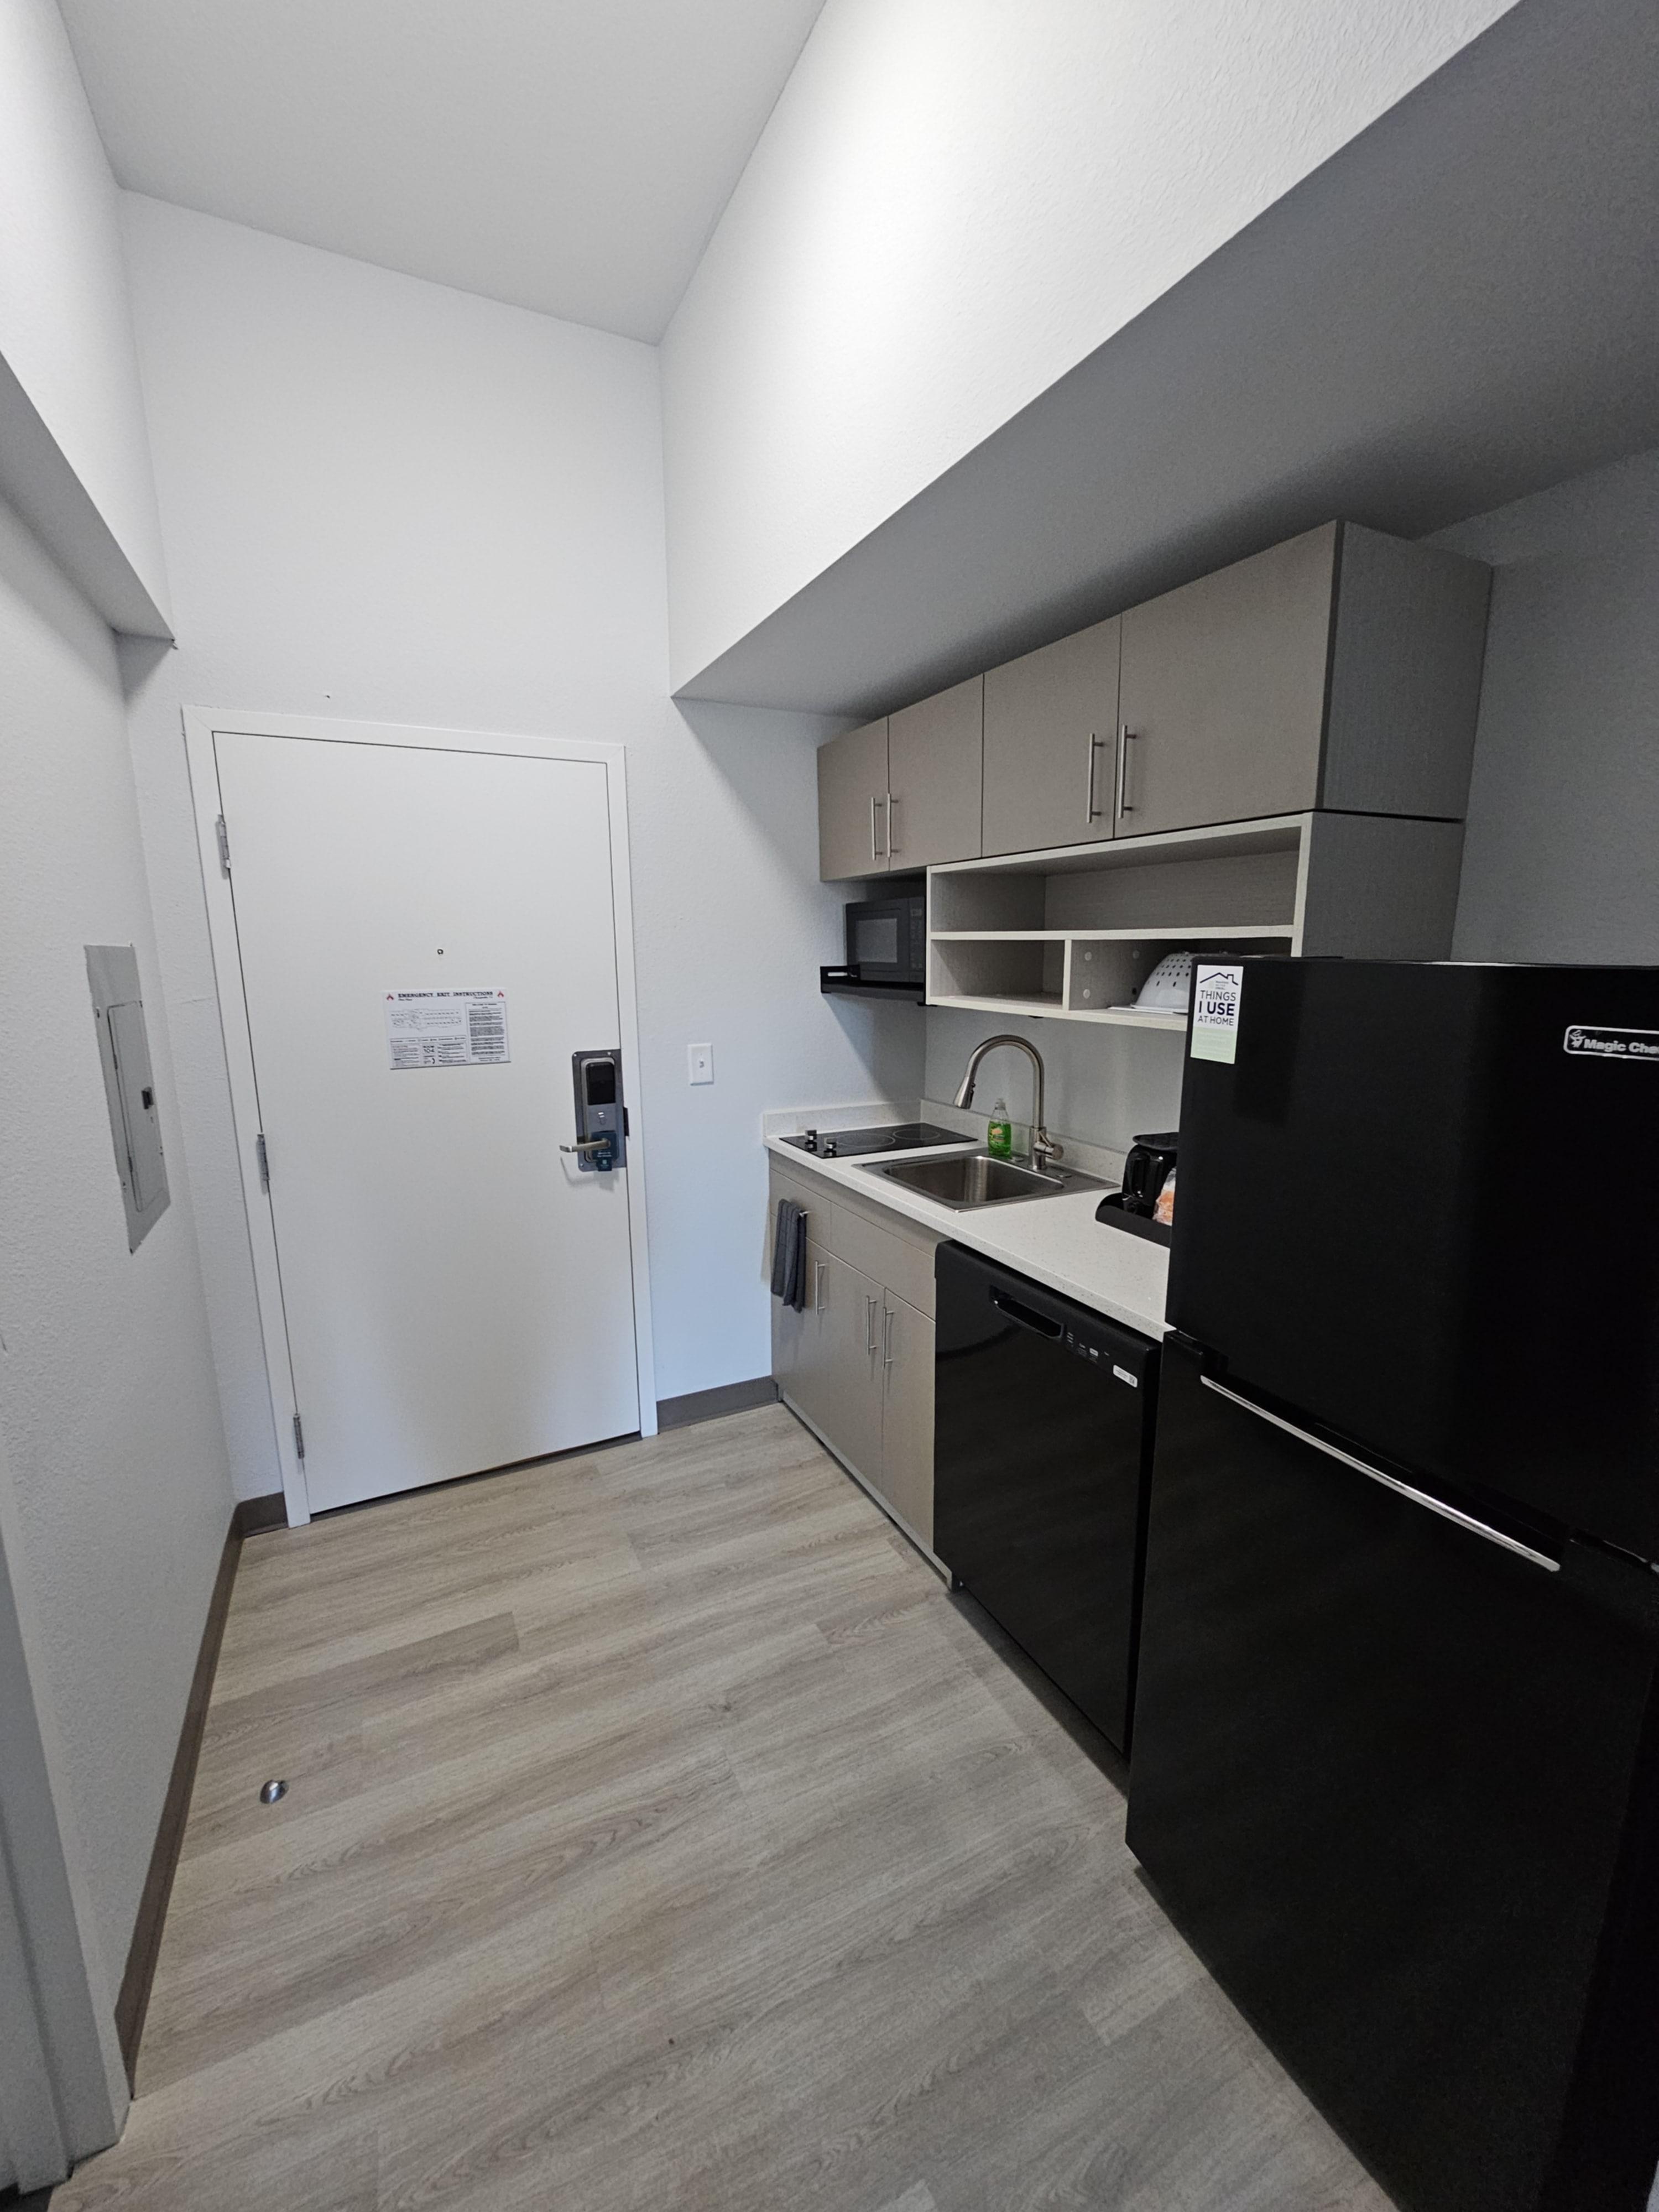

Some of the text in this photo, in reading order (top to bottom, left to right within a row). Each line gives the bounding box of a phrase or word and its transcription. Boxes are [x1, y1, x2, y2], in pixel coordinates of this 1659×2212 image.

[1201, 990, 1236, 1001] THINGS
[1199, 1001, 1235, 1016] I USE
[1209, 1016, 1234, 1026] HOME
[1584, 1039, 1659, 1054] Magic Che
